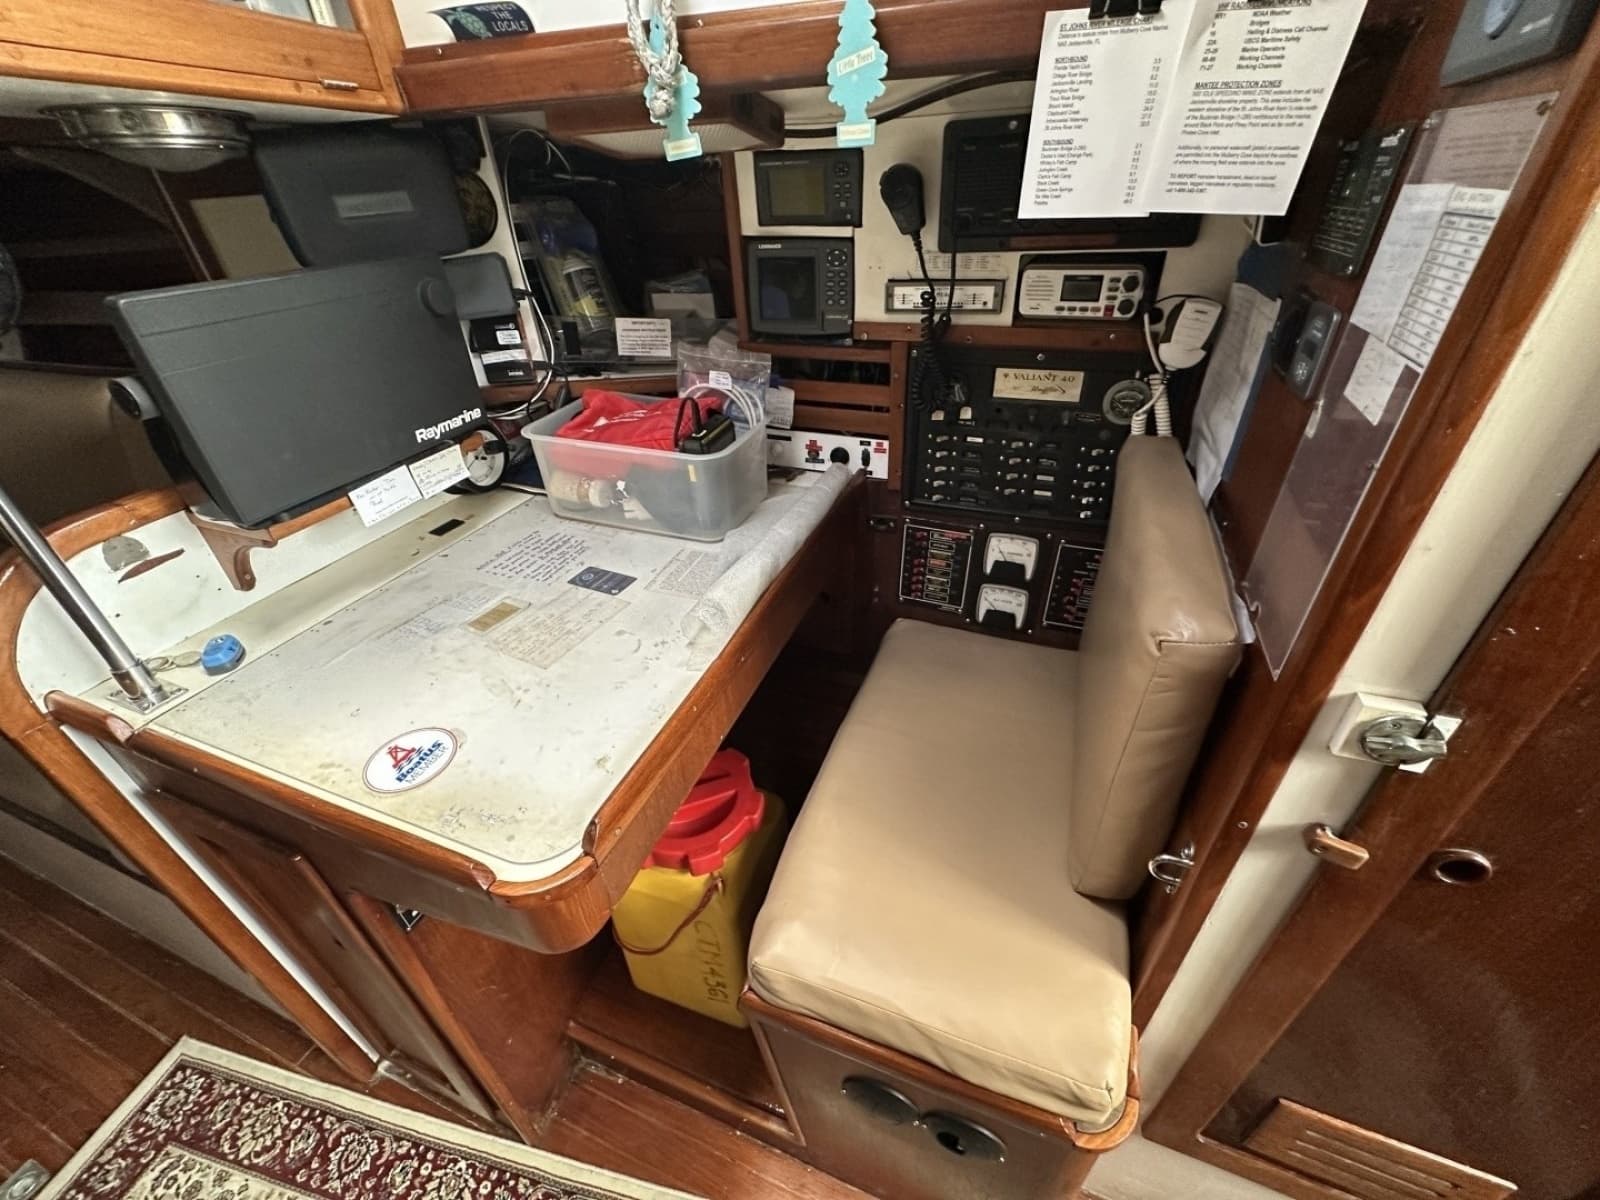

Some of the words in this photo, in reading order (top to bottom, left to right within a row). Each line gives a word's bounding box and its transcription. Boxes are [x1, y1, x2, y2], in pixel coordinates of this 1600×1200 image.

[492, 11, 513, 19] THE
[491, 21, 529, 31] LOCALS
[1014, 372, 1056, 381] VALIANT
[415, 408, 482, 442] Raymarine
[405, 745, 448, 783] MEMBER
